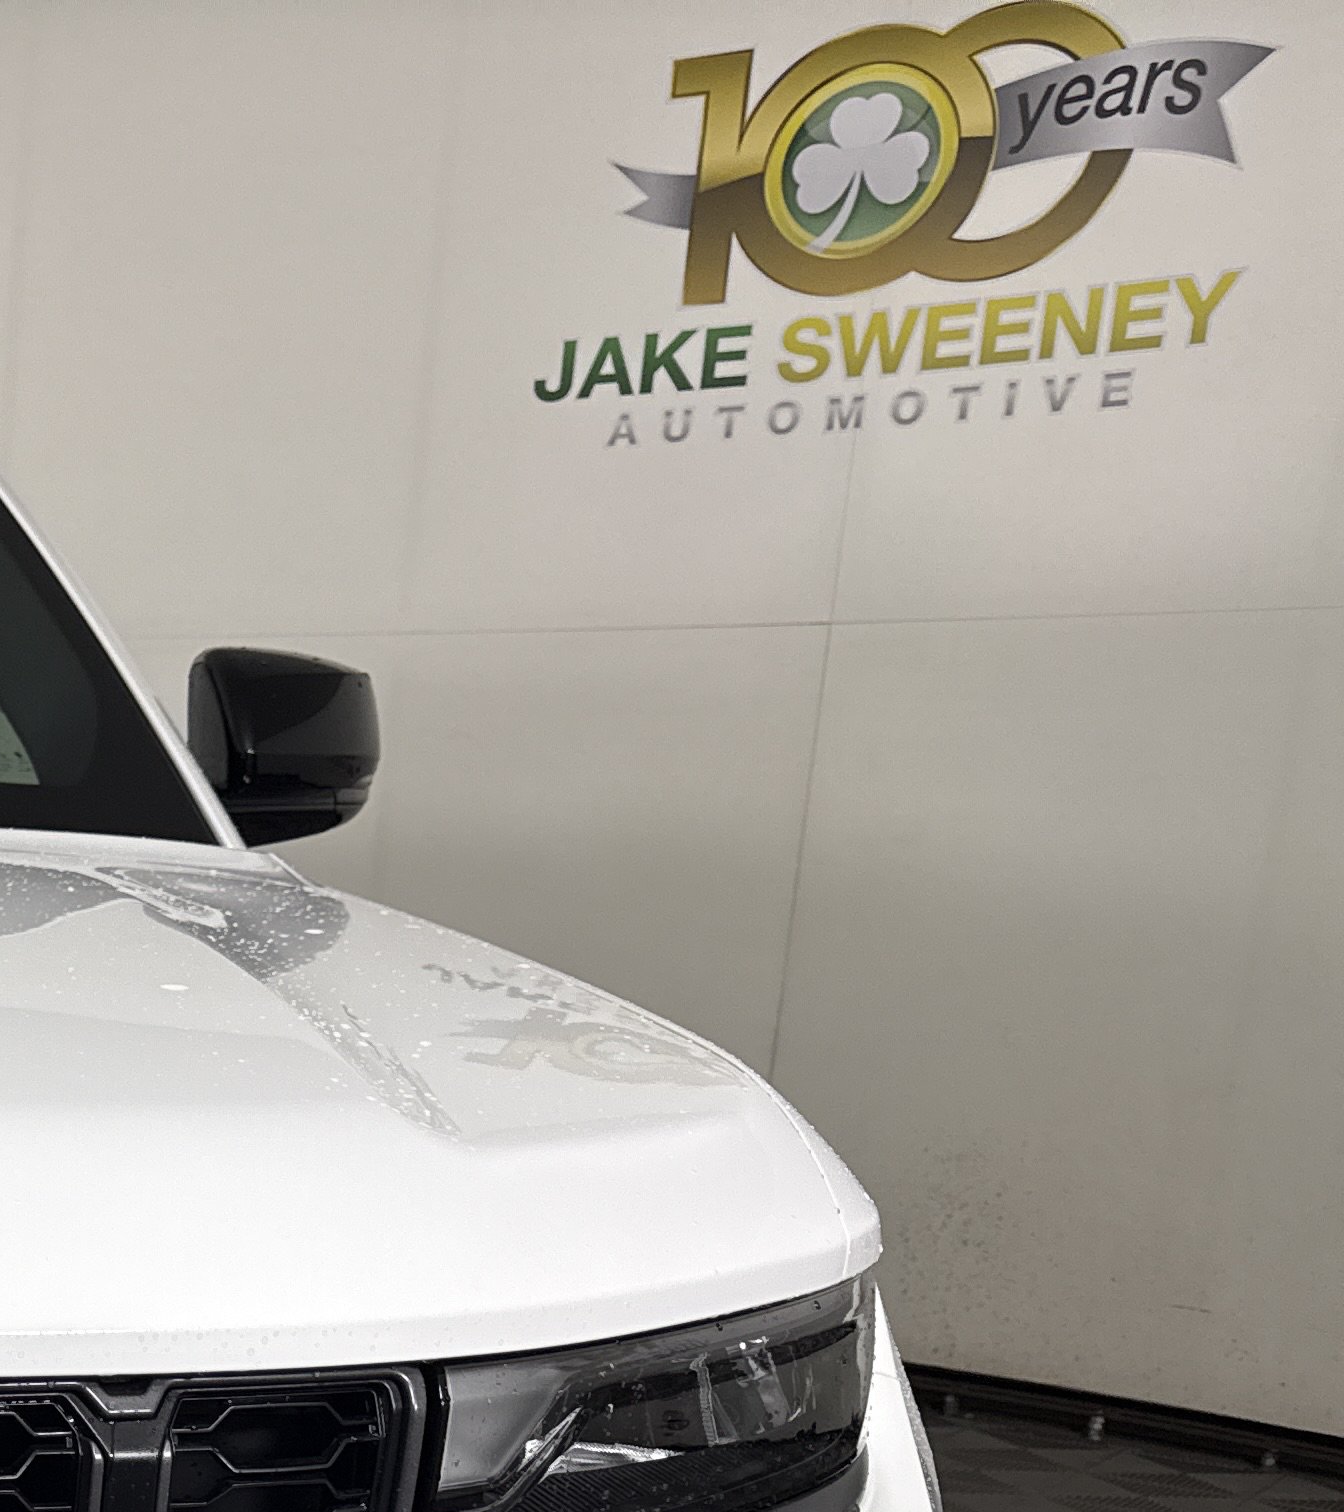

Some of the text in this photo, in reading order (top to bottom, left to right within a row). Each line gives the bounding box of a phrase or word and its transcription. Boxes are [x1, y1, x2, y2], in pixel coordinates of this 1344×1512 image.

[672, 0, 1210, 308] 100 years
[534, 268, 1250, 405] JAKE SWEENEY
[606, 371, 1135, 448] AUTOMOTIVE
